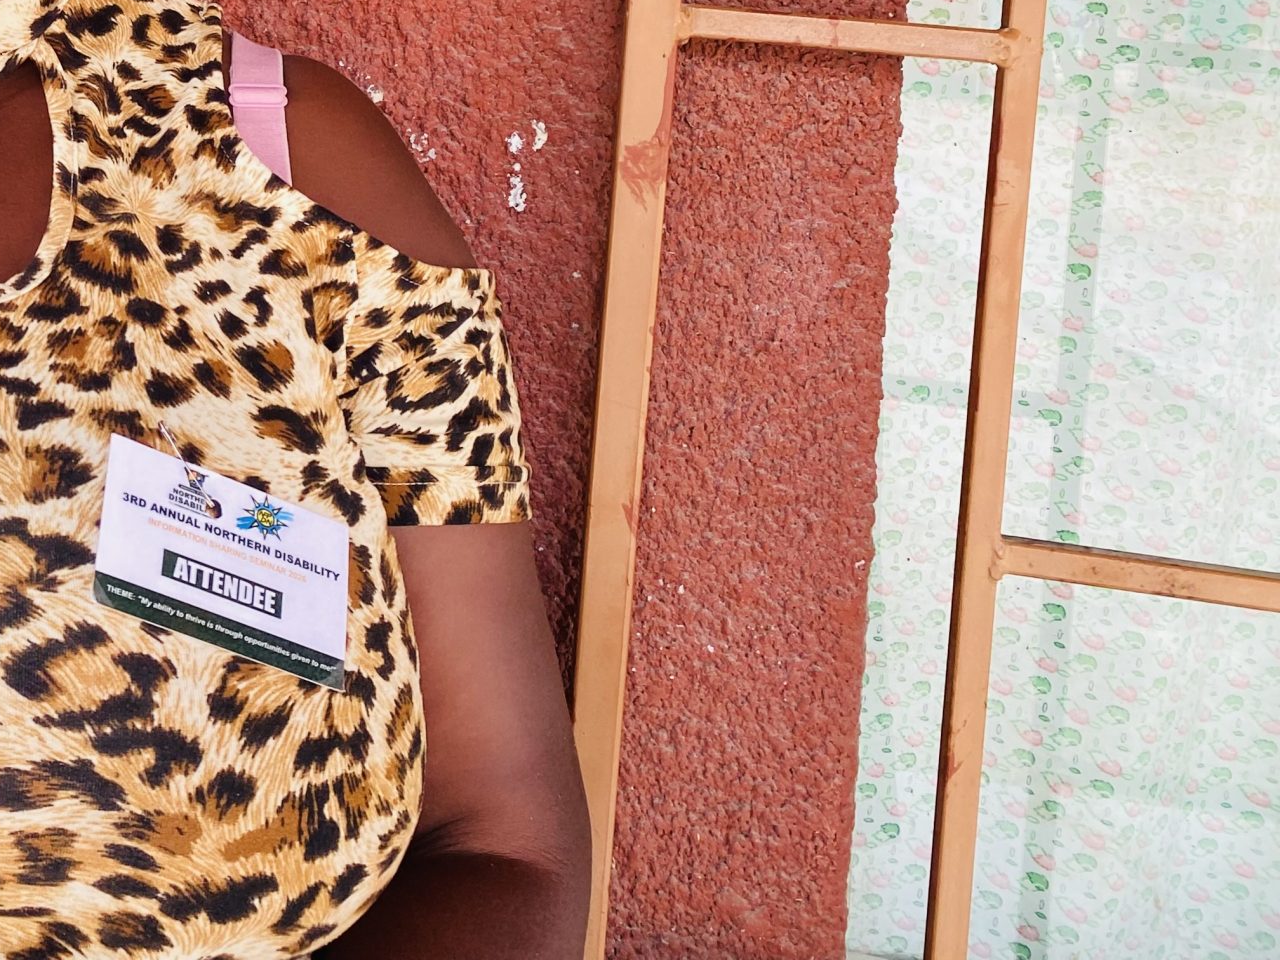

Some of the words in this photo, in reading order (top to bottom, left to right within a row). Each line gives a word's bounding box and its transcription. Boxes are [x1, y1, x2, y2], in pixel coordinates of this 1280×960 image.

[168, 493, 207, 513] DISABIL
[172, 488, 205, 506] NORTHE
[122, 492, 147, 508] 3RD
[150, 503, 201, 529] ANNUAL
[204, 522, 271, 556] NORTHERN
[274, 549, 340, 581] DISABILITY
[148, 517, 208, 545] INFORMATION
[208, 540, 248, 560] SHARING
[249, 554, 287, 576] SEMINAR
[173, 556, 276, 614] ATTENDEE
[106, 584, 136, 600] THEME:
[152, 602, 176, 616] ability
[176, 609, 185, 618] to
[185, 613, 206, 627] thrive
[206, 620, 214, 629] is
[215, 624, 243, 639] through
[244, 635, 290, 657] opportunities
[290, 652, 311, 665] given
[311, 659, 319, 668] to
